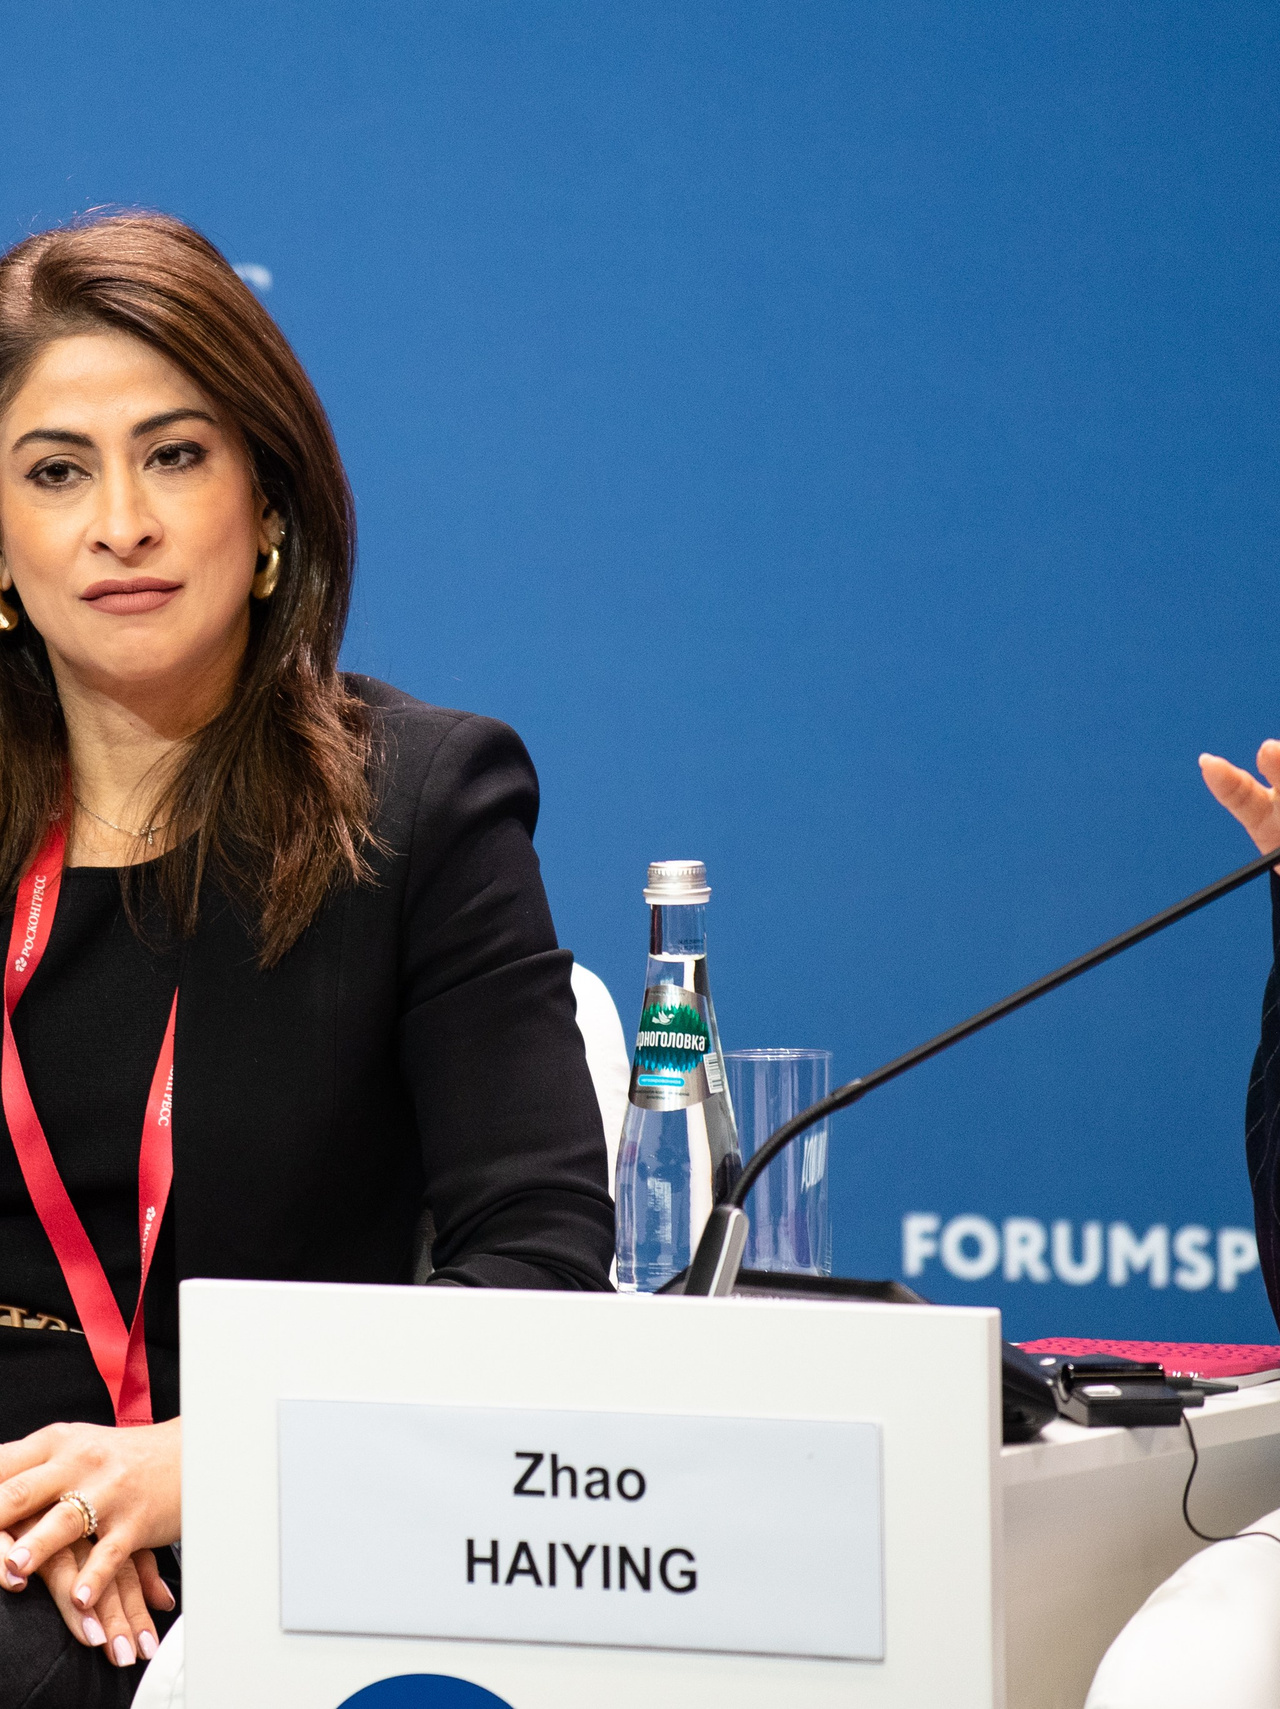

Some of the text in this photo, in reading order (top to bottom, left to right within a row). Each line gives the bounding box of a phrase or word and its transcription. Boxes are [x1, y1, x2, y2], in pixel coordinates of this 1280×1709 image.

[23, 875, 47, 958] РОСКОНГРЕСС
[636, 1031, 706, 1051] рноголовка
[513, 1451, 646, 1501] Zhao
[466, 1538, 697, 1594] HAIYING
